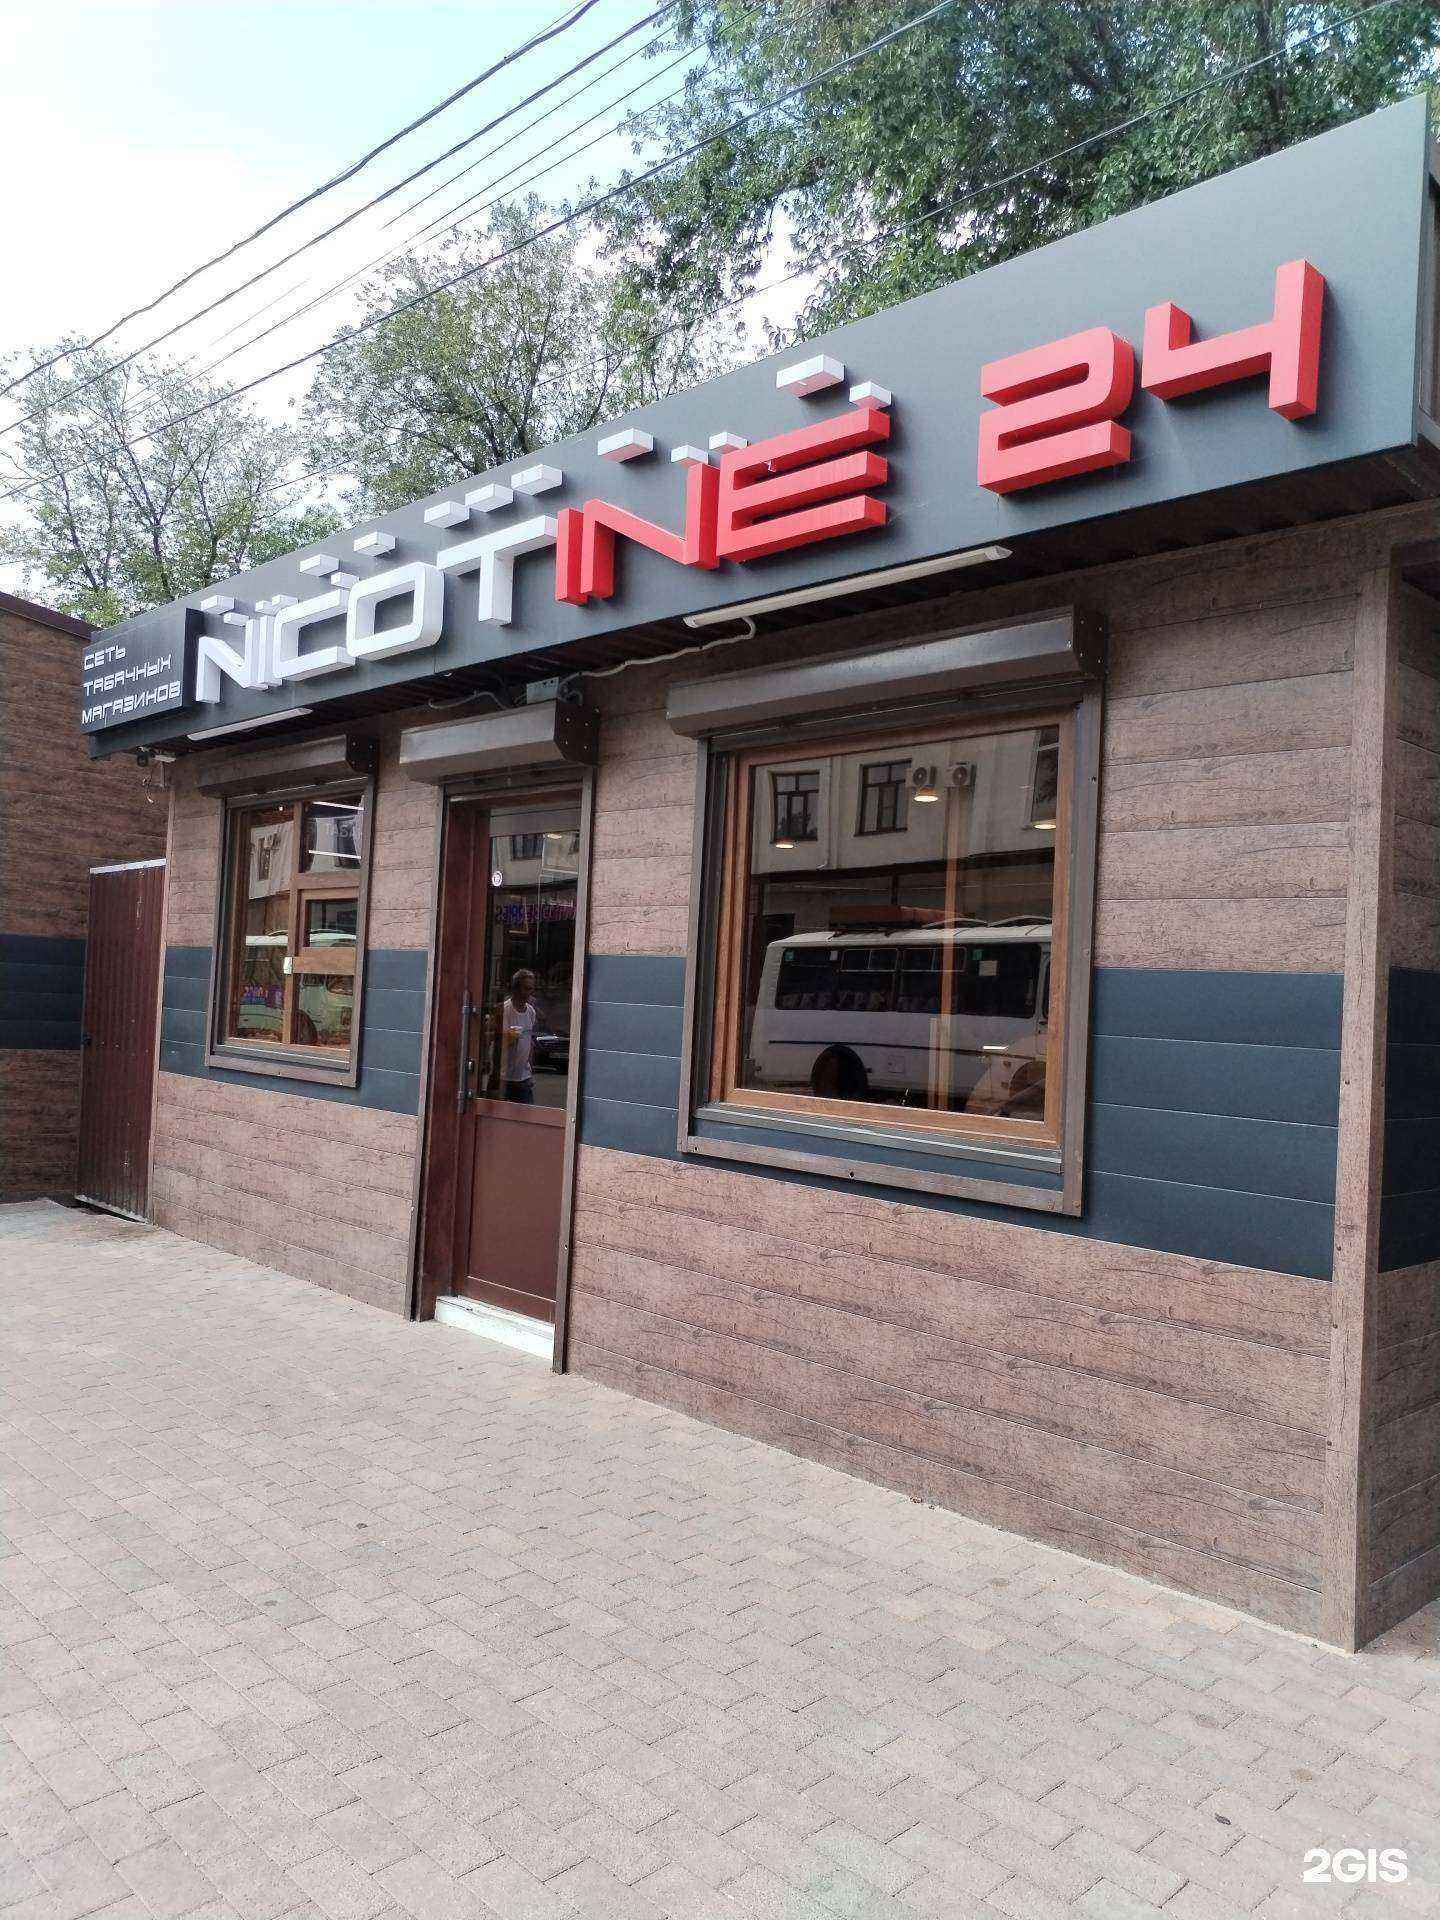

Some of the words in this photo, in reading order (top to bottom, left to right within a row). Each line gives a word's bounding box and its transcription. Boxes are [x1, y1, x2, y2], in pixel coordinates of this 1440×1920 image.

[977, 258, 1326, 495] 24
[82, 653, 172, 697] ТАБАЧНЫХ
[83, 644, 127, 671] СЕТЬ
[81, 680, 182, 725] МАГАЗИНОВ
